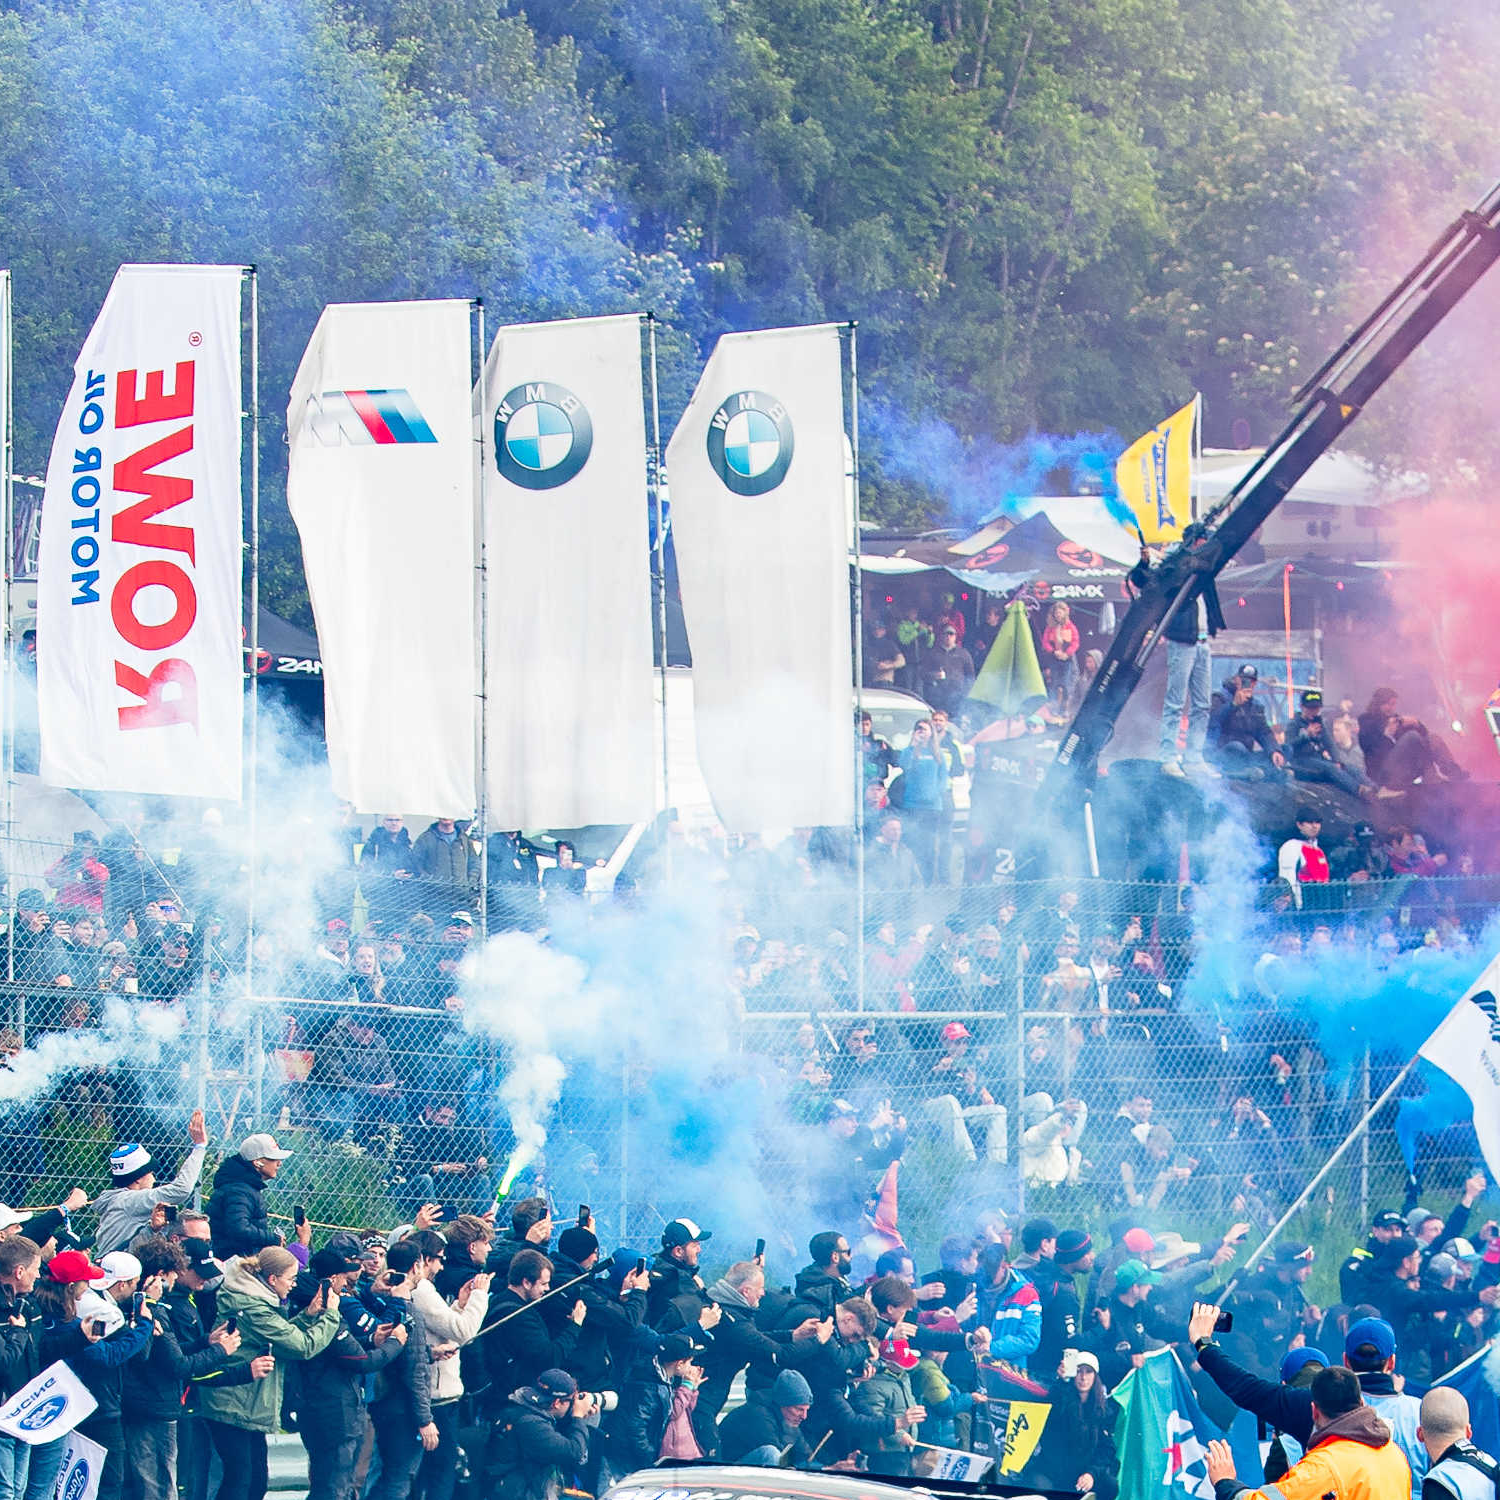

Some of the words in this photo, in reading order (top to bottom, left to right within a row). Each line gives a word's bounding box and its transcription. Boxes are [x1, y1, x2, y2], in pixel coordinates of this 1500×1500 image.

[986, 589, 1009, 600] MX
[1052, 584, 1104, 598] 24MX
[276, 656, 324, 675] 24M
